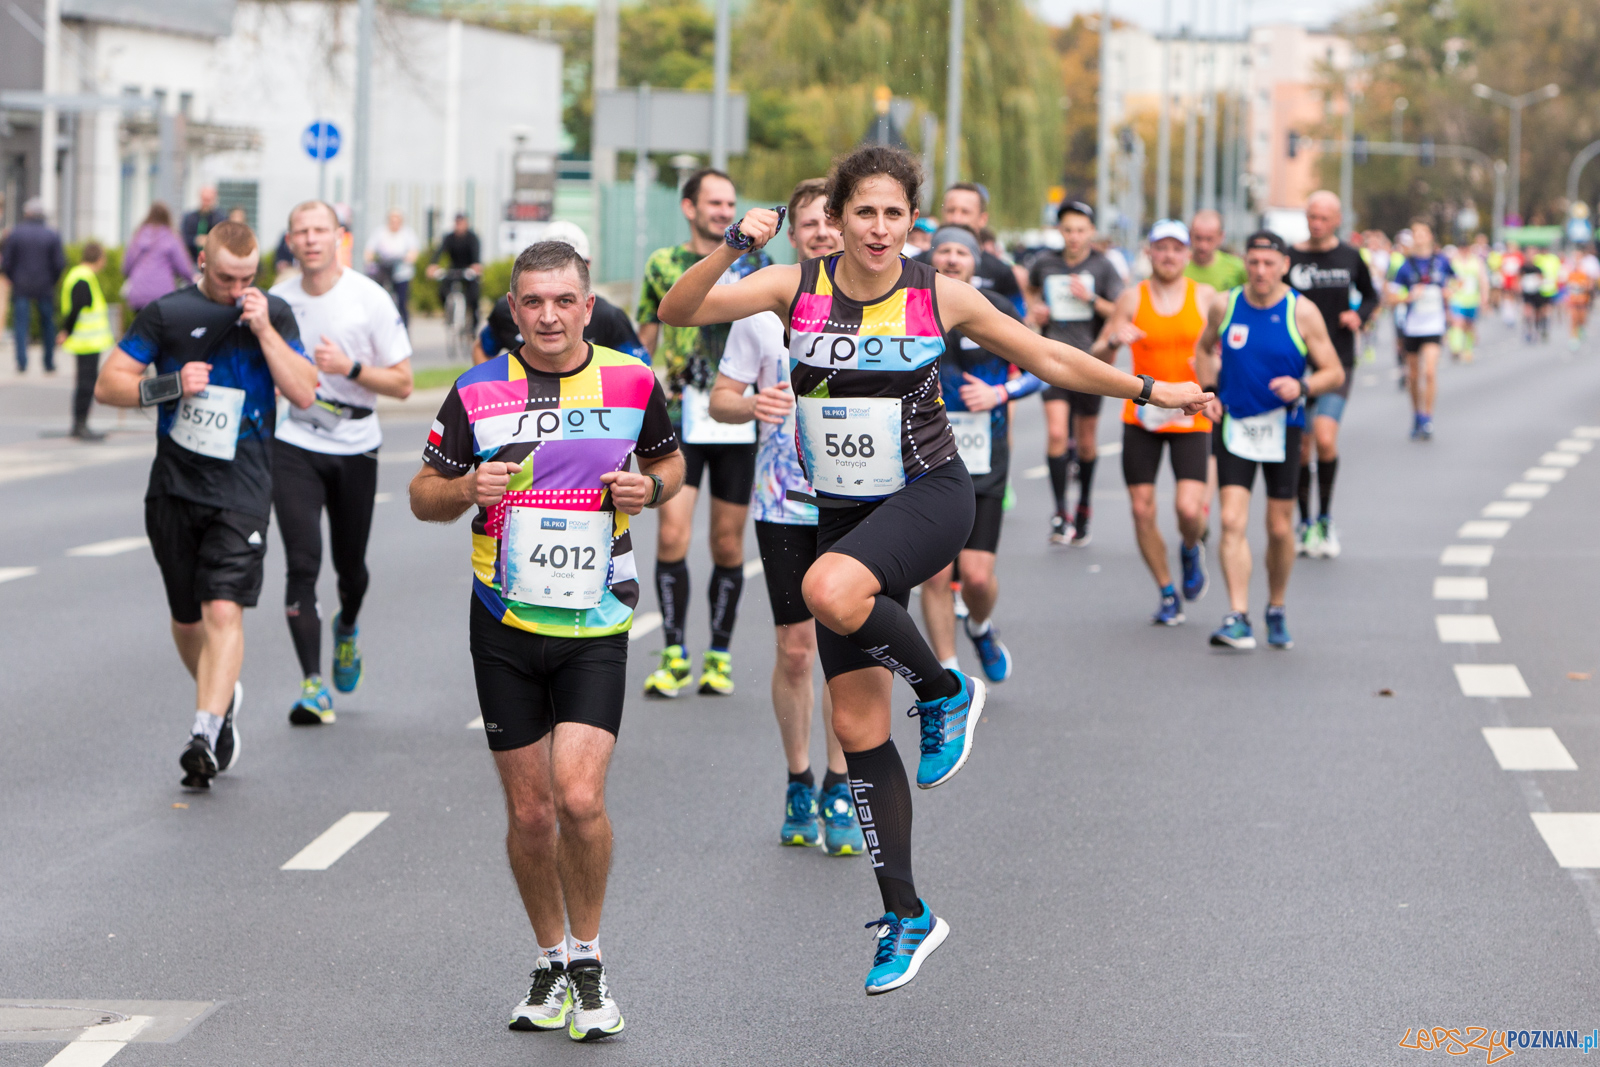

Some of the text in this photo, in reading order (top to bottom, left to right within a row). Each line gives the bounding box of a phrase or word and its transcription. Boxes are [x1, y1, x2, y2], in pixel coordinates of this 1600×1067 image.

[182, 404, 228, 430] 5570
[832, 409, 845, 417] PKO
[825, 433, 875, 458] 568
[955, 433, 985, 450] 00
[835, 459, 867, 469] Patrycja
[529, 544, 596, 570] 4012
[551, 570, 575, 579] Jacek
[850, 779, 885, 869] kalenji
